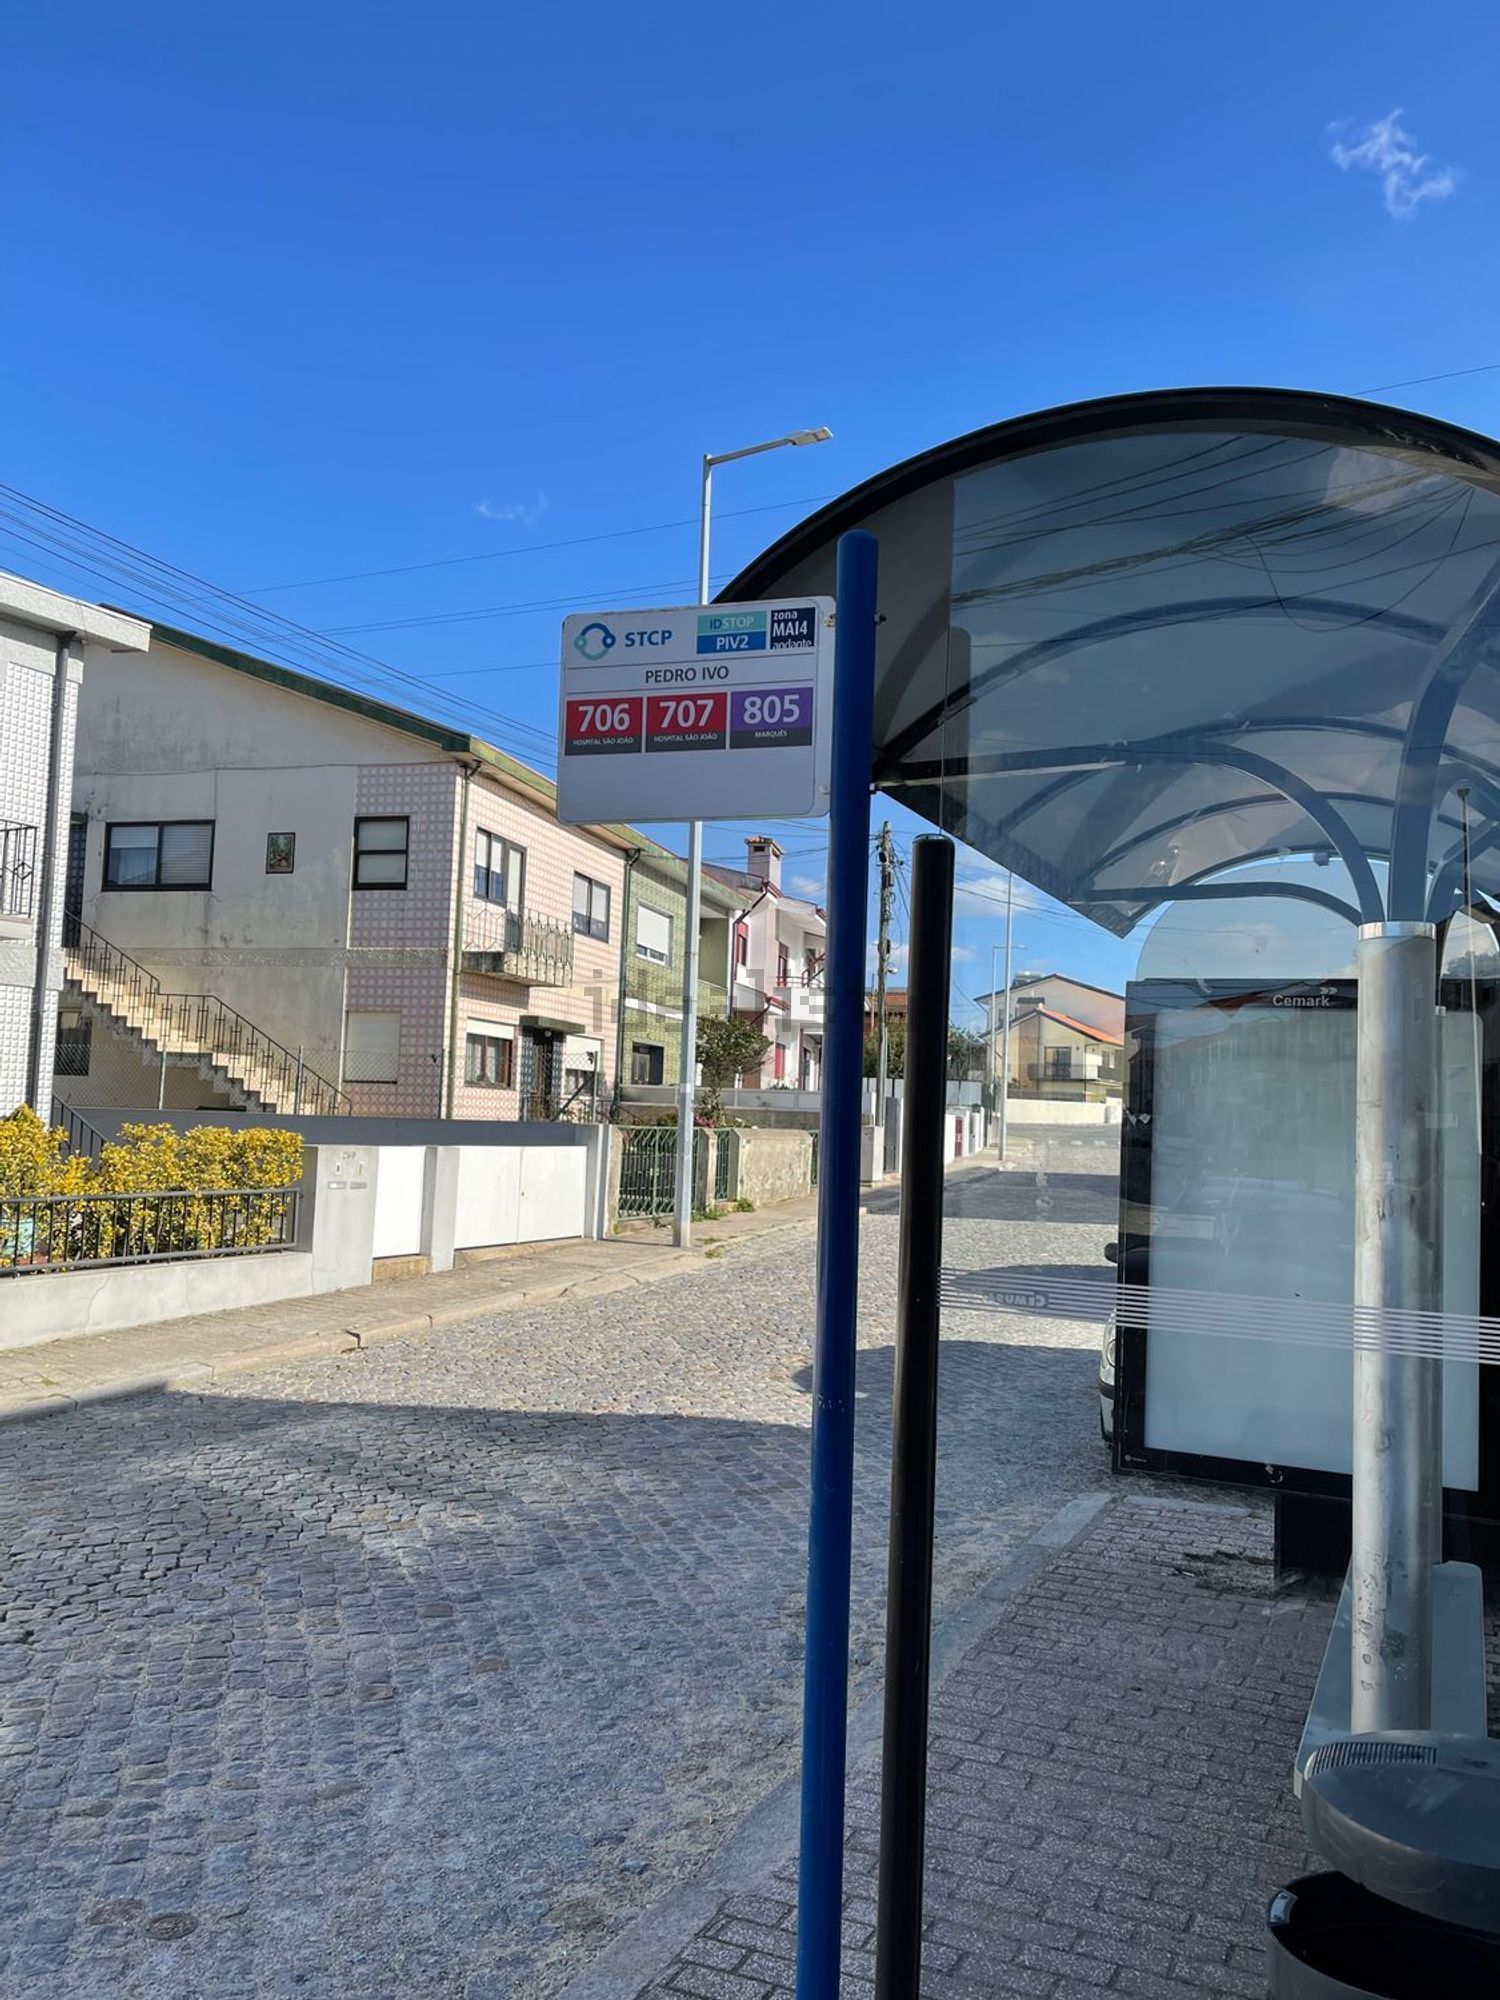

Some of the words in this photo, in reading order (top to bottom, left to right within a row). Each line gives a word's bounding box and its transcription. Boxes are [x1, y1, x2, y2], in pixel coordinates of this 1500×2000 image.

[709, 615, 754, 630] IDSTOP
[773, 610, 798, 620] zona
[772, 620, 808, 637] MAI4
[624, 629, 673, 648] STCP
[716, 635, 749, 650] PIV2
[645, 667, 697, 684] PEDRO
[702, 665, 729, 681] IVO
[659, 699, 714, 729] 707
[743, 694, 800, 725] 805
[577, 703, 631, 733] 706
[572, 738, 602, 746] HOSPITAL
[654, 734, 685, 743] HOSPITAL
[1273, 994, 1330, 1007] Cemark
